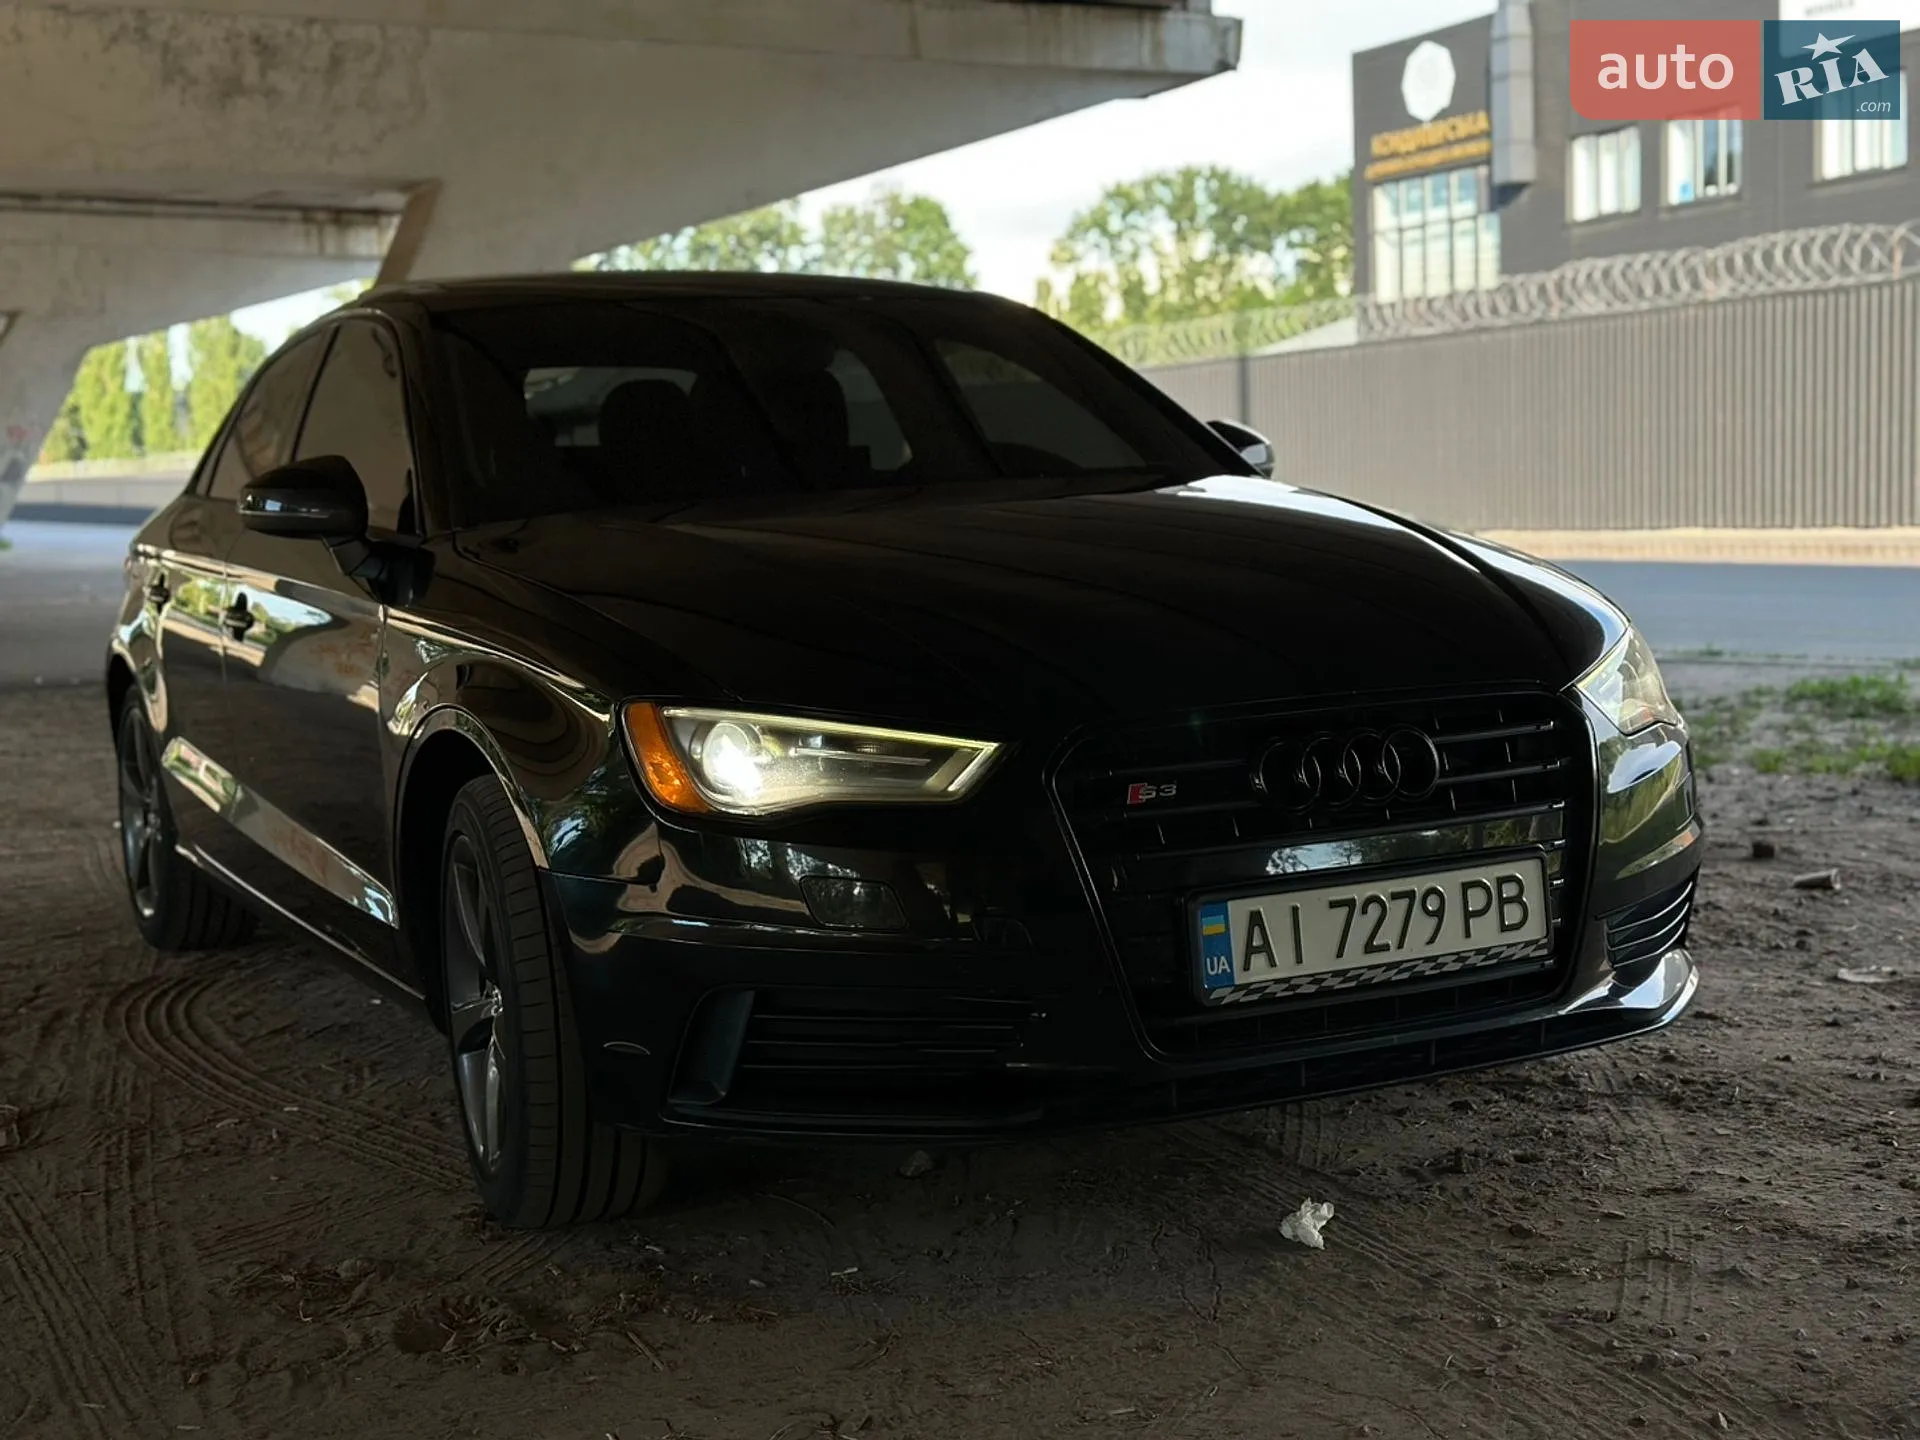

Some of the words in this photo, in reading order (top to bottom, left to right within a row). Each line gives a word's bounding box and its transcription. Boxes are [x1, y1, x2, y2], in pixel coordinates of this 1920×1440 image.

[1135, 783, 1177, 800] S3
[1243, 903, 1304, 971] AI
[1329, 886, 1447, 958] 7279
[1461, 873, 1529, 938] PB
[1206, 956, 1231, 976] UA
